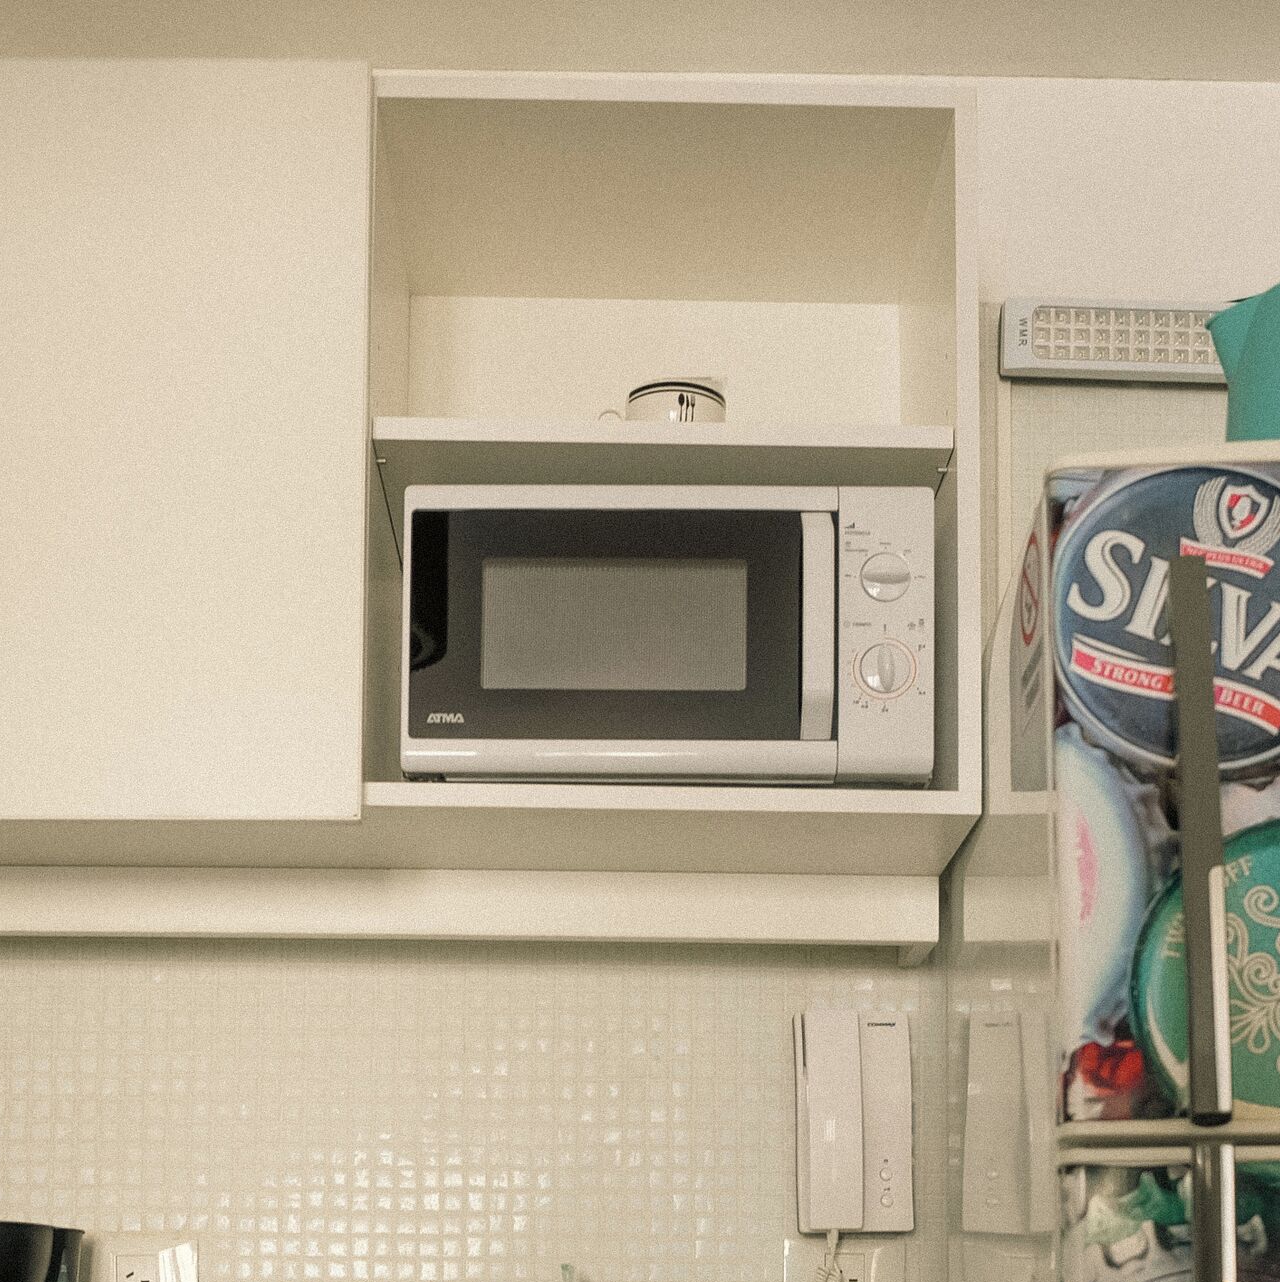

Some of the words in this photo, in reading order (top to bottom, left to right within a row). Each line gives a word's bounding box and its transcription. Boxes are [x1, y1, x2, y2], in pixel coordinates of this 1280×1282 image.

[1091, 660, 1165, 691] STRONG
[1220, 686, 1266, 715] BEER
[426, 712, 465, 724] ATMA
